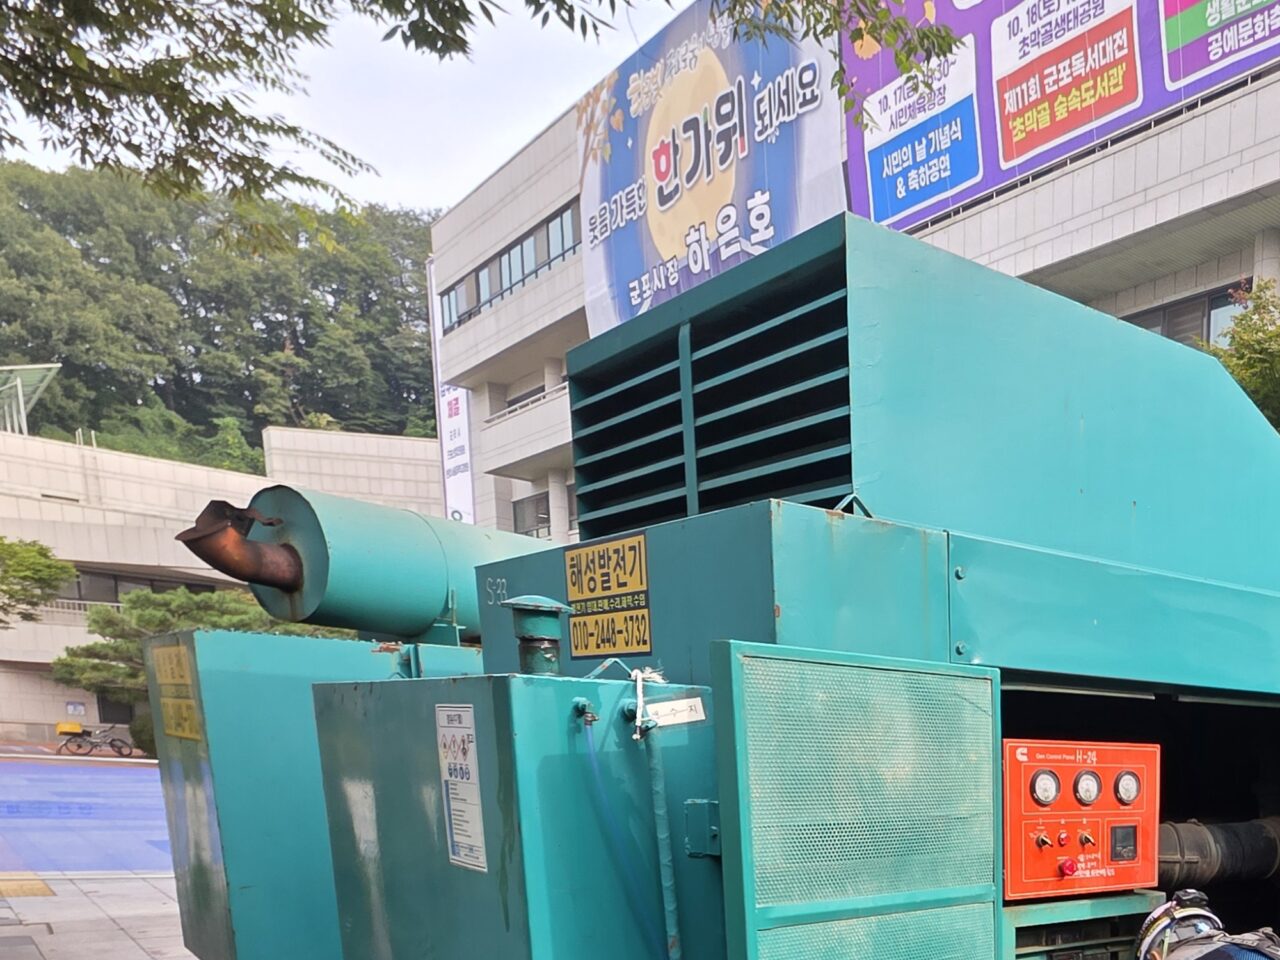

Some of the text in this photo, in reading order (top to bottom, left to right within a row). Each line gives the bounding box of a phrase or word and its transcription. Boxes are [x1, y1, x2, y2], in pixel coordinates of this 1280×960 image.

[1007, 16, 1023, 40] 10.
[1018, 0, 1105, 60] 초막골생태공원
[1004, 27, 1128, 115] 제11회 군포독서대전
[652, 80, 746, 208] 한가위
[755, 62, 820, 141] 되세요
[882, 117, 962, 179] 시민의 날 기념식
[897, 153, 952, 199] & 축하공연
[628, 256, 680, 306] 군포시장
[570, 541, 644, 595] 해성발전기
[572, 614, 648, 651] 010-2448-3732
